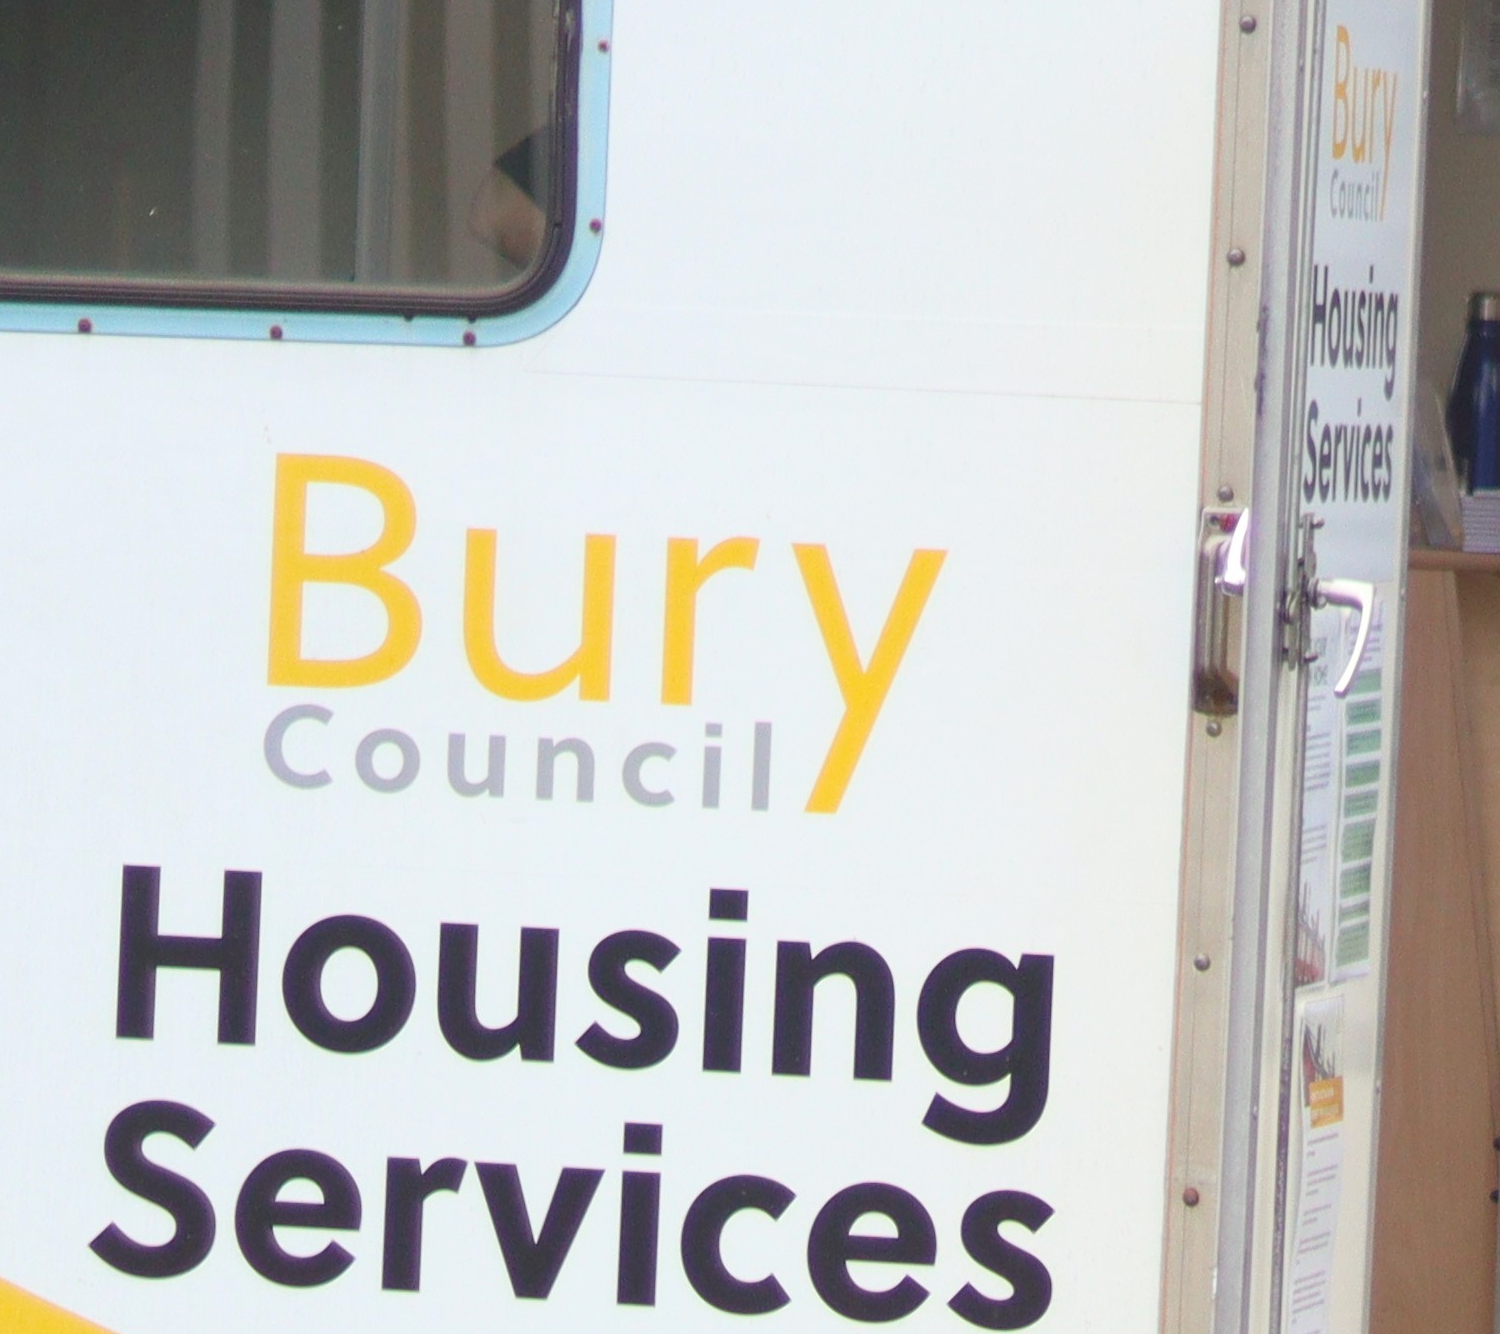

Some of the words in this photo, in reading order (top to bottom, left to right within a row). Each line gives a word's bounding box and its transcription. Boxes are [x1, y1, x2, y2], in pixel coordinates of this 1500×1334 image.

[1329, 168, 1380, 221] Council
[1331, 25, 1397, 221] Bury
[1309, 264, 1399, 402] Housing
[1303, 397, 1394, 504] Services
[267, 453, 948, 814] Bury
[263, 702, 772, 813] Council
[114, 863, 1055, 1147] Housing
[87, 1099, 1055, 1331] Services
